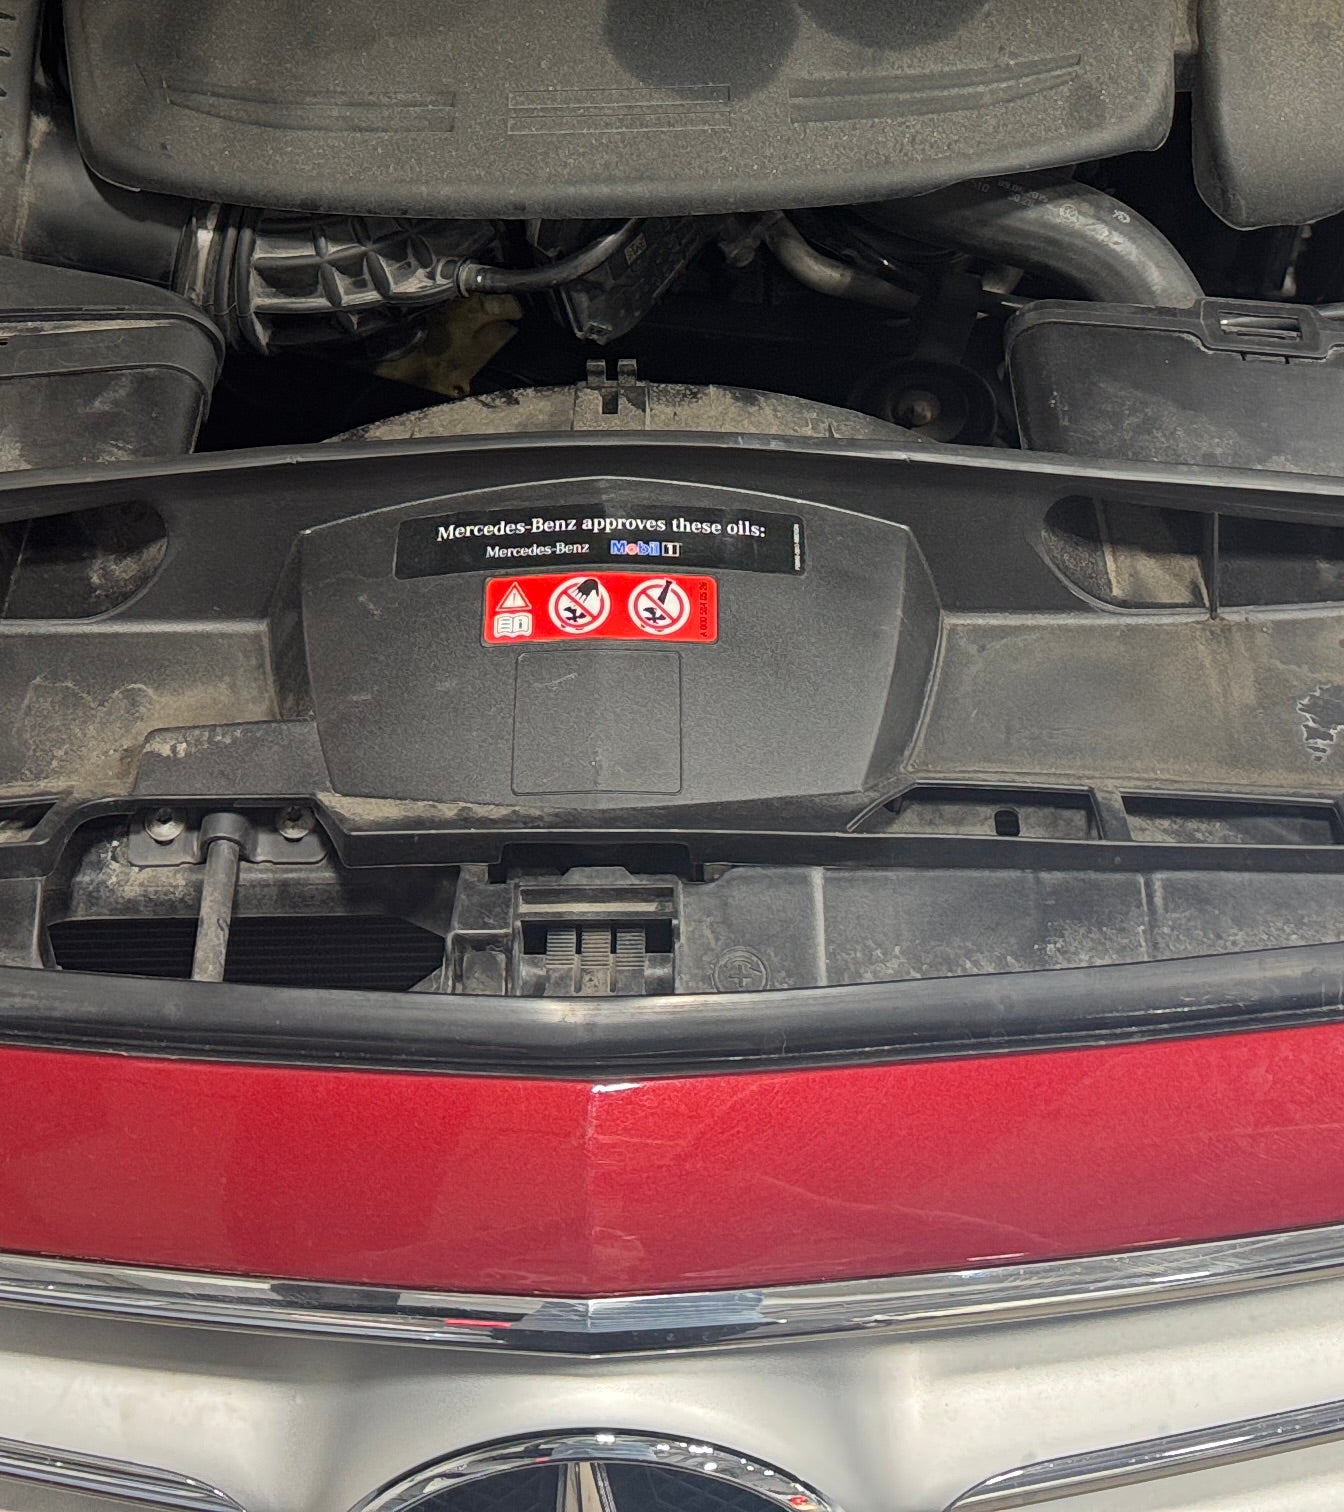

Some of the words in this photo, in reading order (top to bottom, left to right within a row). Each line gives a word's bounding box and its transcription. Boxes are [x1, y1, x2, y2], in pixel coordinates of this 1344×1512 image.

[436, 517, 576, 542] Mercedes-Benz
[582, 515, 667, 535] approves
[671, 516, 722, 536] these
[726, 520, 767, 538] oils:
[485, 541, 590, 559] Mercedes-Benz
[610, 540, 660, 556] Mobil
